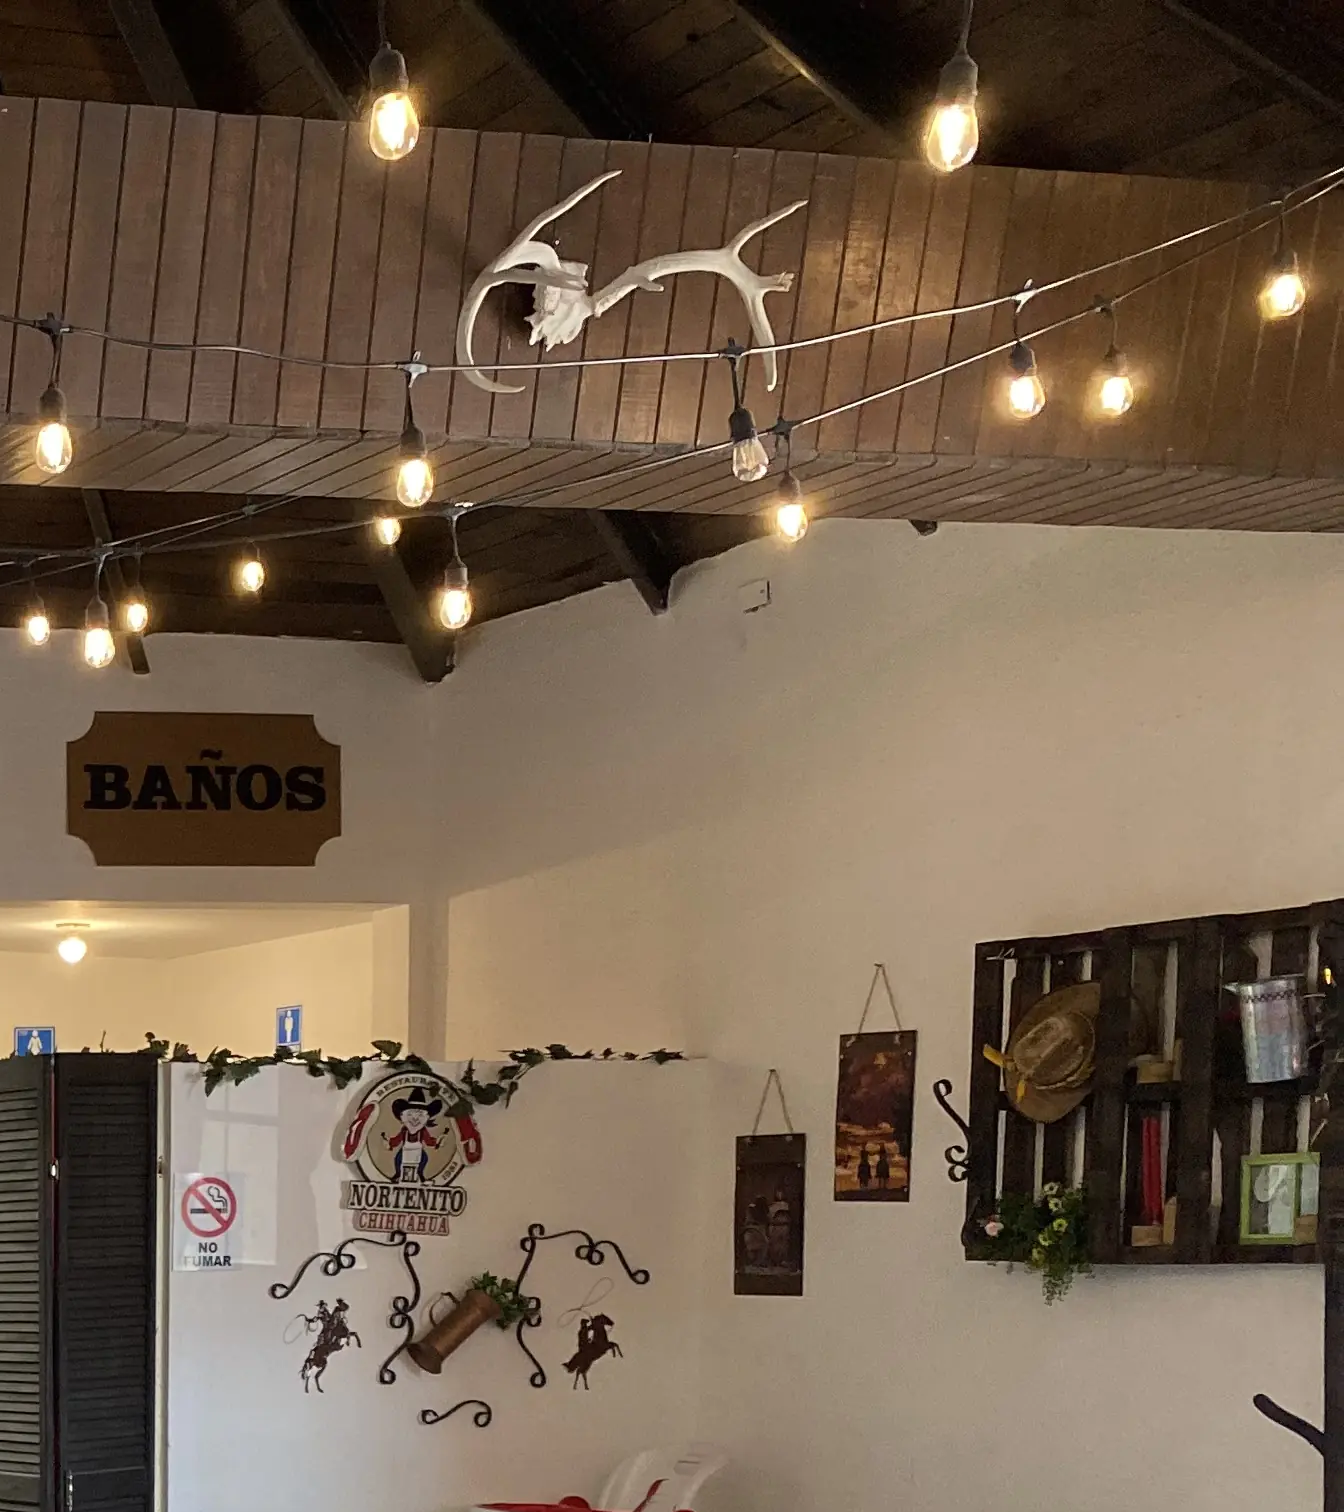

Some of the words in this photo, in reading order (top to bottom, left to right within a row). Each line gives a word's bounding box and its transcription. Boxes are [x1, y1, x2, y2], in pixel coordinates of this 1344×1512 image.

[83, 749, 326, 811] BAÑOS
[402, 1165, 419, 1183] EL
[358, 1211, 448, 1234] CHIHUAHUA
[198, 1242, 218, 1253] NO
[183, 1255, 232, 1267] FUMAR
